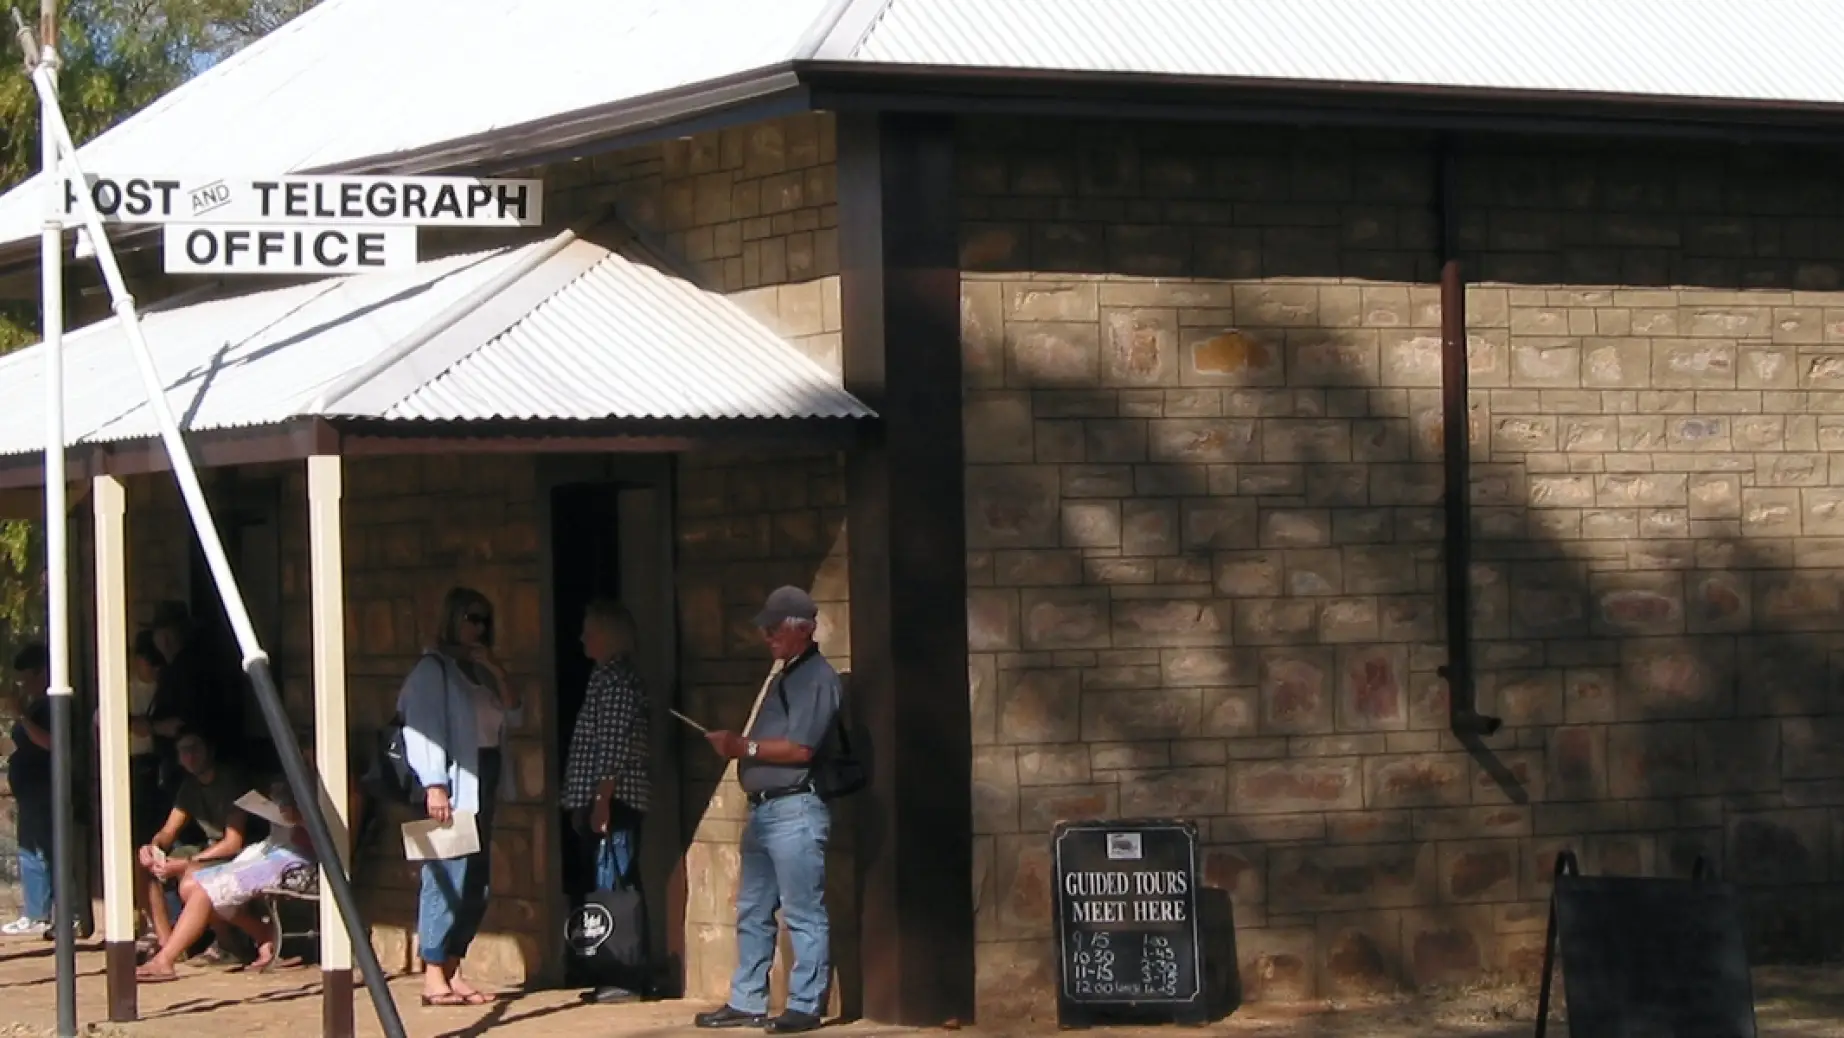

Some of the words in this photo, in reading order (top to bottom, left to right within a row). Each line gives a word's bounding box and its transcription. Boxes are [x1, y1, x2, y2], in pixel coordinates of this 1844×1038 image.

[191, 183, 231, 211] AND
[252, 180, 528, 219] TELEGRAPH
[186, 228, 387, 266] OFFICE
[1065, 871, 1129, 896] GUIDED
[1133, 870, 1188, 895] TOURS
[1072, 900, 1127, 923] MEET
[1134, 900, 1187, 922] HERE
